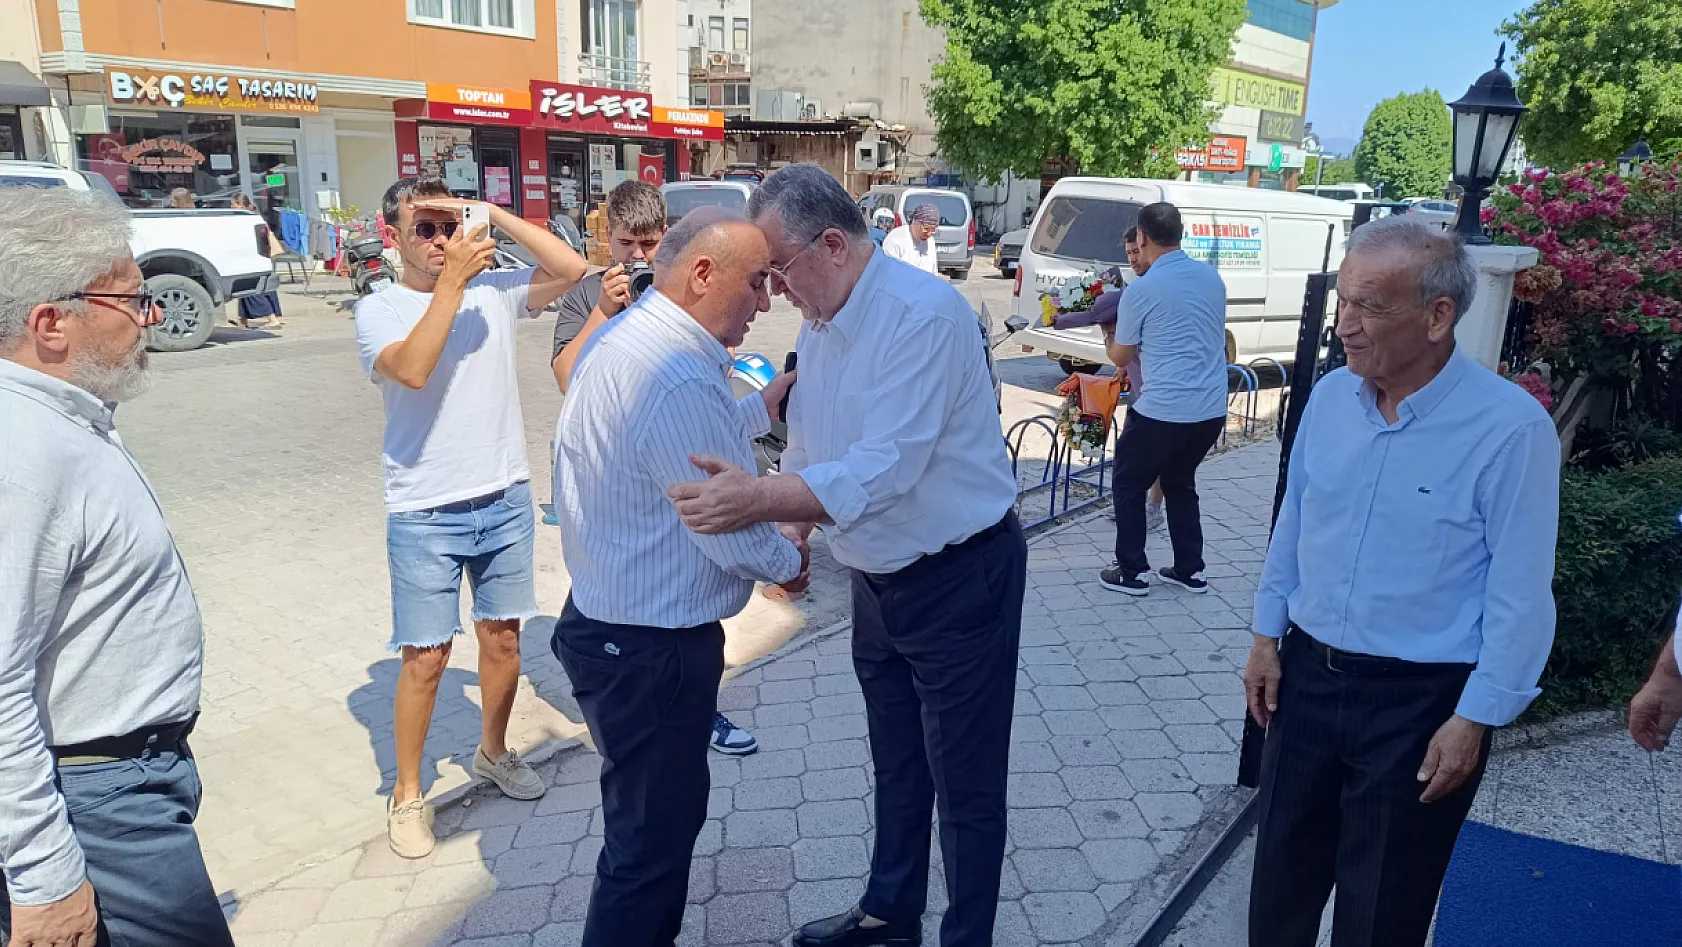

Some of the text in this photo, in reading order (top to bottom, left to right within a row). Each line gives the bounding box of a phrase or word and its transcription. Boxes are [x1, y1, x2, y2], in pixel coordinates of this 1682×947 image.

[190, 75, 229, 95] SAÇ
[238, 78, 317, 101] TASARIM
[456, 88, 504, 104] TOPTAN
